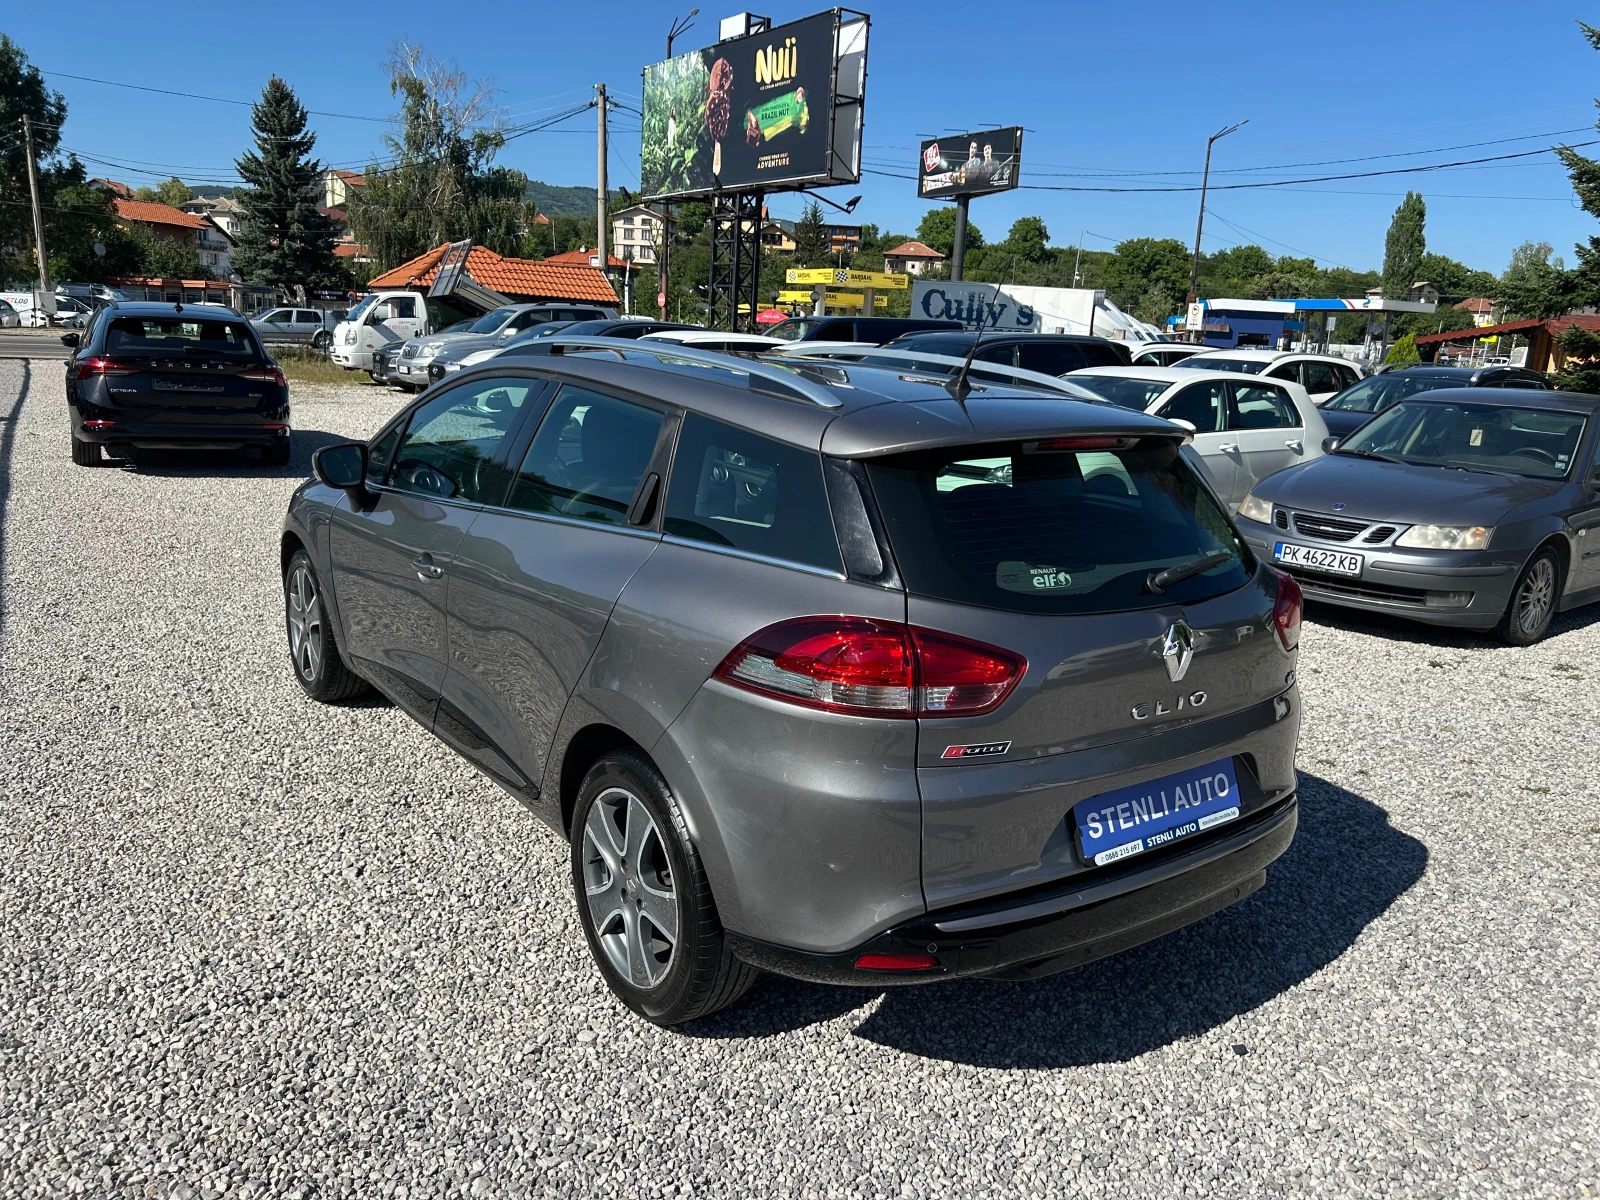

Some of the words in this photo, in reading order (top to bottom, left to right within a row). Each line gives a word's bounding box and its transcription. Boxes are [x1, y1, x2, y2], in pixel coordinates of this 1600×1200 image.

[761, 110, 778, 121] BRAZIL
[778, 108, 790, 117] NUT
[757, 158, 790, 169] ADVENTURE
[850, 273, 873, 283] BARDAHL
[1282, 546, 1301, 562] PK
[1303, 549, 1337, 568] 4622
[1338, 555, 1358, 571] KB
[1030, 567, 1057, 575] RENAULT
[1032, 574, 1057, 588] elf
[1131, 690, 1208, 721] CLIO
[1086, 791, 1170, 839] STENLI
[1174, 773, 1229, 812] AUTO
[1146, 830, 1174, 847] STENLI
[1175, 822, 1197, 838] AUTO
[1119, 846, 1130, 856] 215
[1130, 843, 1140, 852] 697
